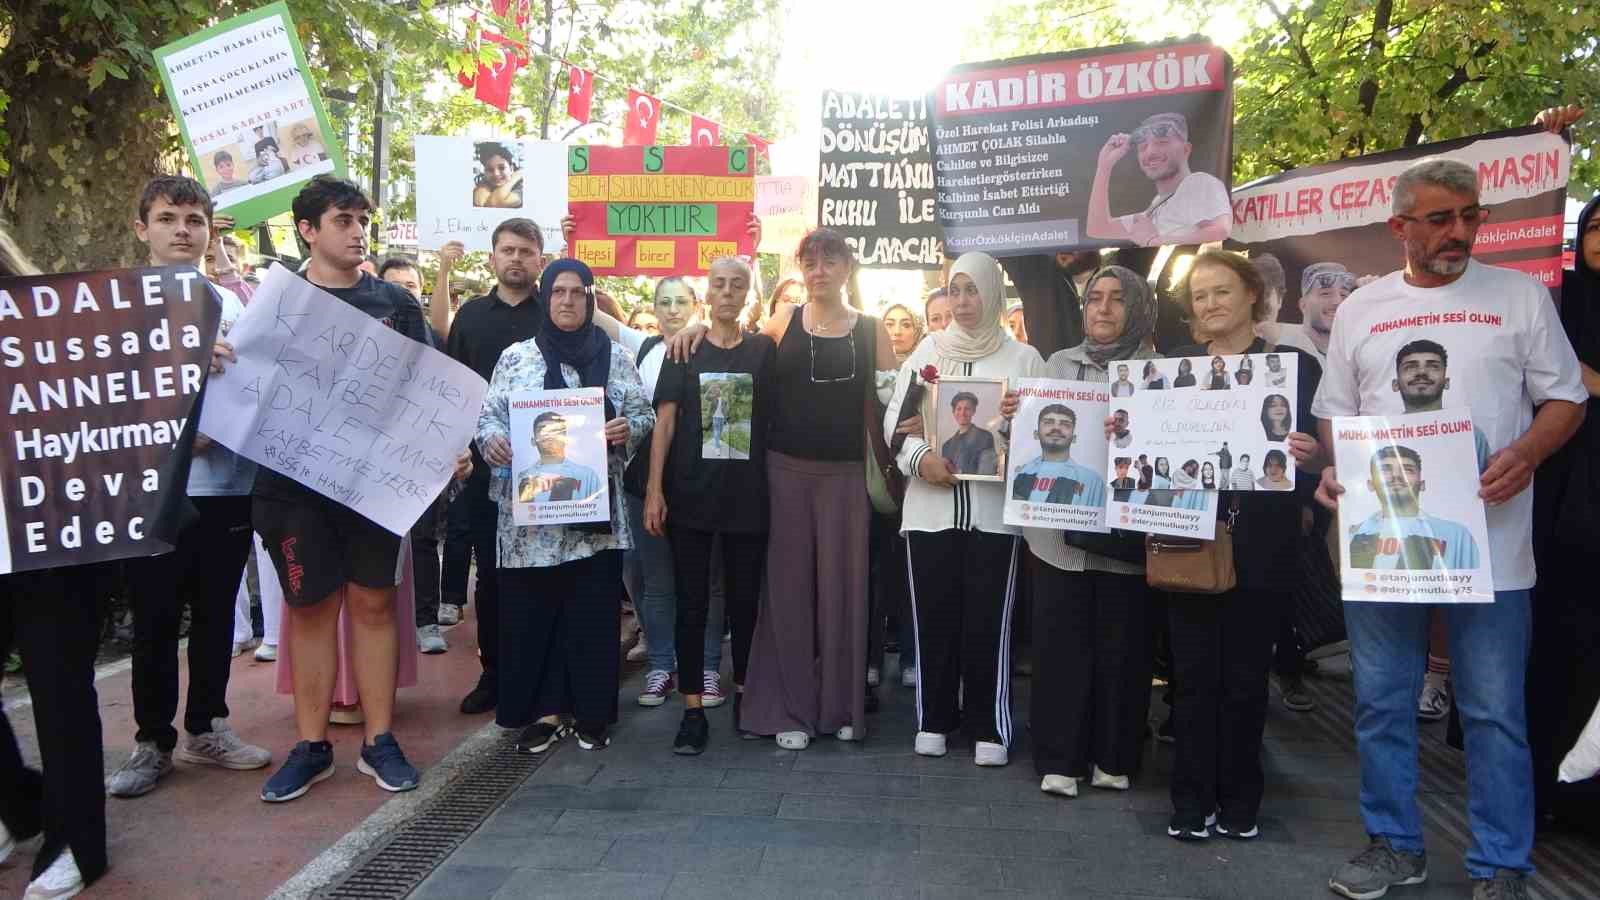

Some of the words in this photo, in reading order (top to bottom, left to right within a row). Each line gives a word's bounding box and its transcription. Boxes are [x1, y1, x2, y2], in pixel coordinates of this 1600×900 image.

[945, 71, 1066, 112] KADİR
[1077, 52, 1212, 100] ÖZKÖK
[935, 125, 959, 139] Özel
[962, 123, 1008, 137] Harekat
[1011, 118, 1044, 132] Polisi
[936, 141, 979, 155] AHMET
[982, 137, 1023, 154] ÇOLAK
[1026, 133, 1067, 146] Silahla
[572, 147, 588, 173] S
[645, 146, 664, 172] S
[980, 159, 991, 168] ve
[995, 153, 1049, 168] Bilgisizce
[822, 198, 877, 226] RUHU
[898, 190, 935, 223] İLE
[938, 191, 980, 203] Kalbine
[983, 187, 1018, 201] İsabet
[609, 204, 709, 234] YOKTUR
[992, 206, 1014, 217] Can
[1017, 202, 1041, 214] Aldı
[578, 243, 611, 264] Hepsi
[639, 247, 671, 262] birer
[0, 272, 198, 321] ADALET
[1370, 312, 1440, 335] MUHAMMETİN
[1443, 310, 1466, 323] SESİ
[1469, 313, 1503, 326] OLUN!
[0, 318, 200, 368] Sussada
[8, 363, 201, 415] ANNELER
[1076, 389, 1094, 401] SESİ
[14, 418, 188, 464] Haykırmay
[1416, 420, 1439, 438] SESİ
[1440, 419, 1472, 435] OLUN!
[20, 468, 160, 508] Deva
[25, 515, 145, 553] Edec
